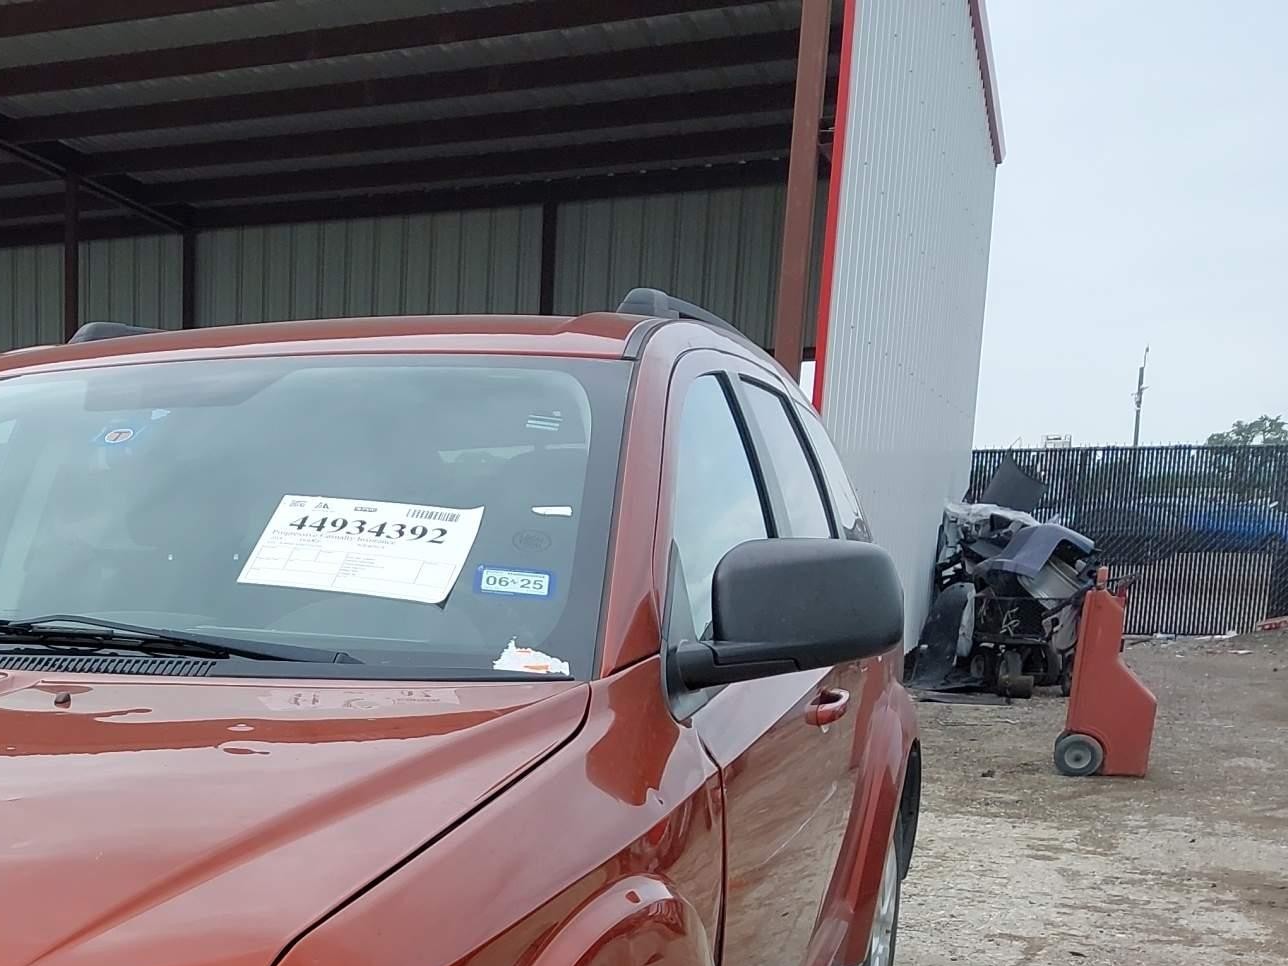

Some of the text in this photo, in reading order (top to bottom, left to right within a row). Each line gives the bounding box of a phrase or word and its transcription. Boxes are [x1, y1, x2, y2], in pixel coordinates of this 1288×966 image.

[288, 514, 449, 545] 44934392
[485, 575, 544, 590] 06 25
